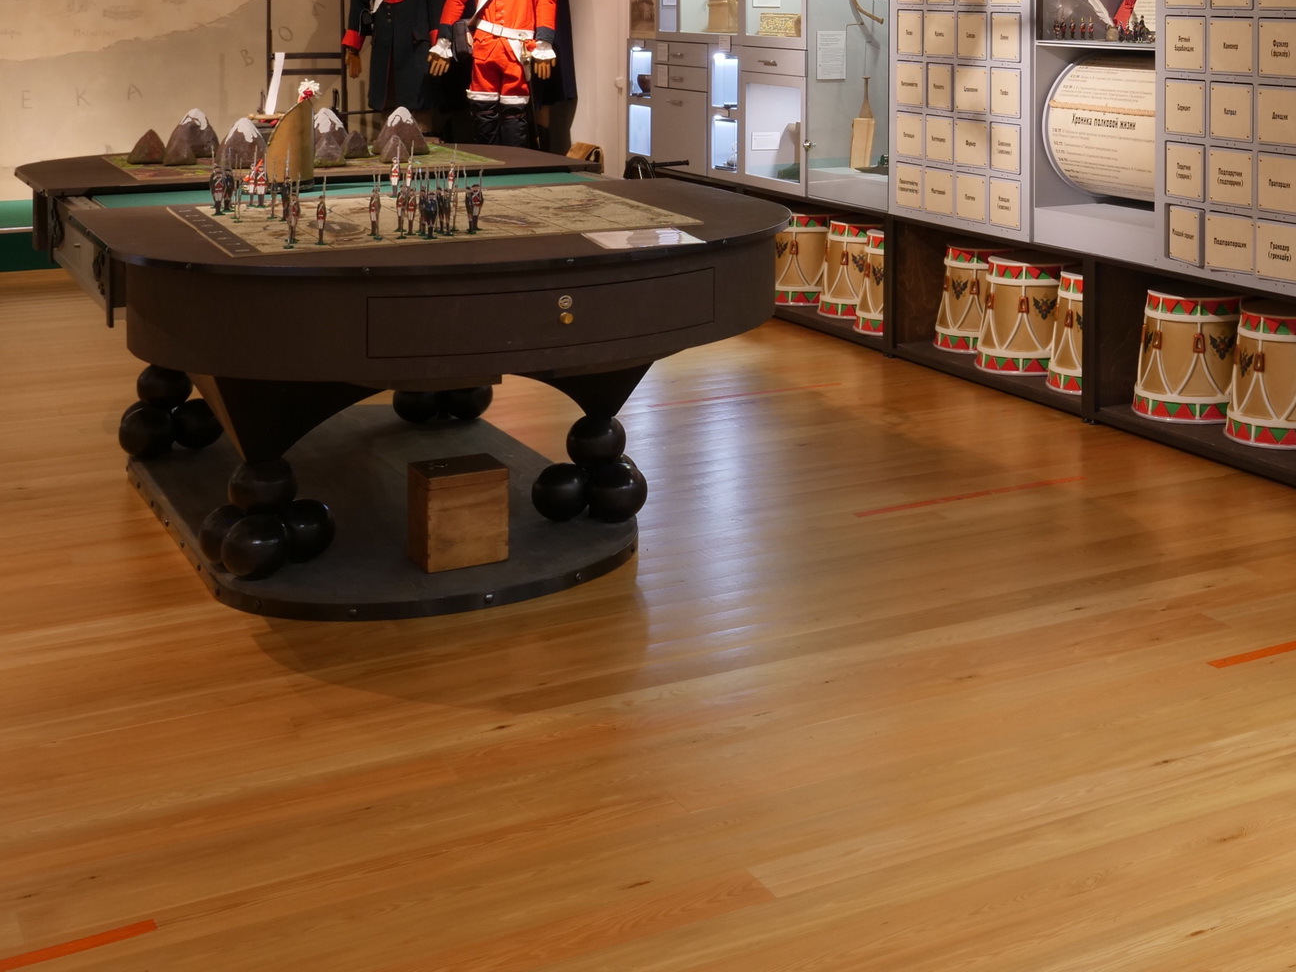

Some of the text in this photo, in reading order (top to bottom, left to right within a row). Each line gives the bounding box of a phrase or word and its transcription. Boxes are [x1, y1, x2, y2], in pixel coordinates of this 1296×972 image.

[1272, 112, 1288, 120] Денщик
[1072, 113, 1136, 130] Хроника полковой жизни
[1268, 179, 1290, 188] Прапорщик
[1214, 237, 1247, 248] Подпрапорщик
